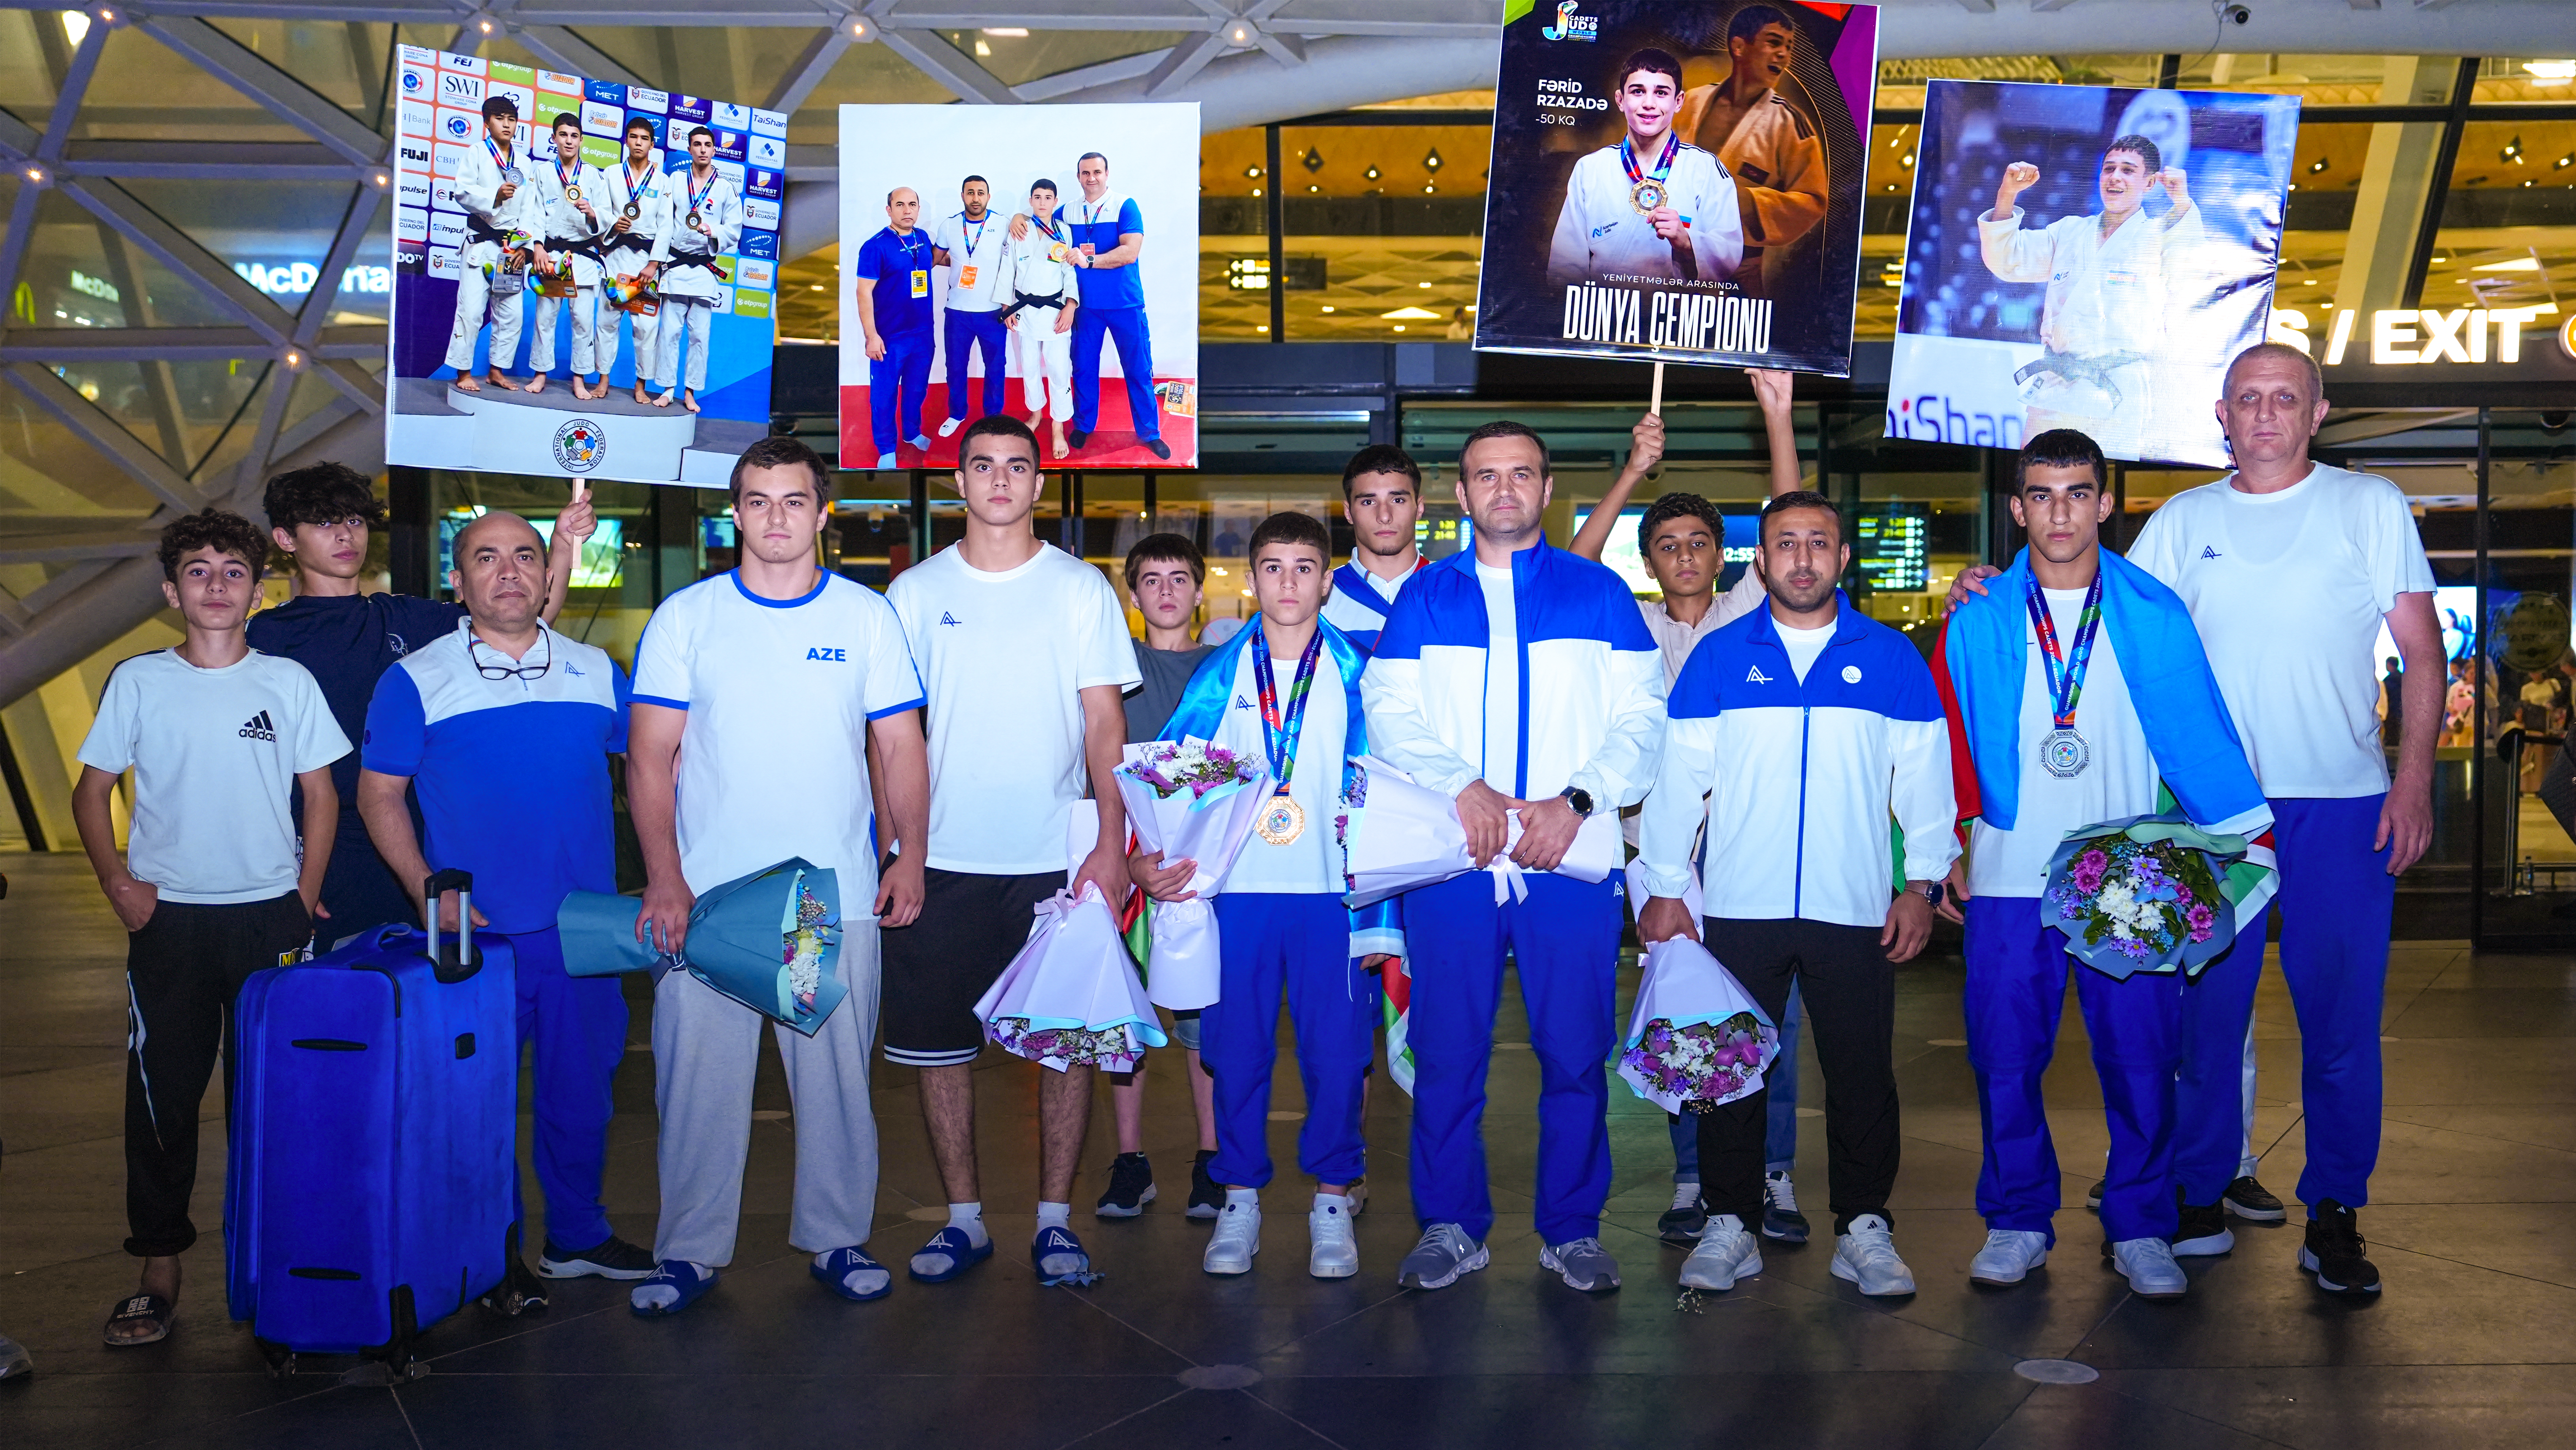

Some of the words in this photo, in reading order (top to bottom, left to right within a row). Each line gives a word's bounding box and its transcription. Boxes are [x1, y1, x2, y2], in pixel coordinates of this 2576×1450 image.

[446, 76, 478, 97] SWI
[1538, 78, 1582, 93] FƏRİD
[596, 90, 619, 100] MET
[641, 95, 666, 103] ECUADOR
[1537, 94, 1608, 110] RZAZADƏ
[675, 105, 705, 116] HARVEST
[412, 115, 431, 125] Bank
[754, 114, 786, 128] TaiShan
[1535, 114, 1555, 124] -50
[1559, 115, 1575, 126] KQ
[401, 148, 428, 162] FUJI
[590, 149, 618, 159] otpgroup
[713, 146, 742, 156] HARVEST
[436, 156, 455, 165] CBH
[400, 186, 427, 194] pulse
[750, 185, 777, 194] HARVEST
[442, 225, 464, 234] impul
[750, 248, 770, 256] MET
[235, 262, 390, 293] McDna
[1603, 273, 1683, 287] YENİYETMƏLƏR
[1686, 279, 1739, 290] ARASINDA
[744, 300, 768, 309] otpgroup
[1563, 281, 1641, 344] DÜNYA
[1649, 290, 1772, 354] ÇEMPİONU
[2371, 309, 2536, 364] EXIT
[555, 427, 573, 469] INTERNATIONAL
[589, 431, 604, 467] FEDERATION
[2033, 594, 2047, 630] CHAMPIONSHIPS
[2044, 631, 2053, 651] CADETS
[2053, 668, 2061, 694] ECUADOR
[806, 648, 846, 662] AZE
[2065, 682, 2075, 710] GUAYAQUIL
[2072, 661, 2080, 681] WORLD
[2081, 606, 2094, 646] CHAMPIONSHIPS
[1261, 662, 1270, 699] CHAMPIONSHIPS
[1279, 754, 1288, 783] GUAYAQUIL
[1292, 680, 1305, 719] CHAMPIONSHIPS
[1302, 661, 1310, 679] CADETS
[1312, 630, 1321, 650] ECUADOR
[239, 726, 276, 743] adidas
[117, 1310, 154, 1319] GIVENCHY
